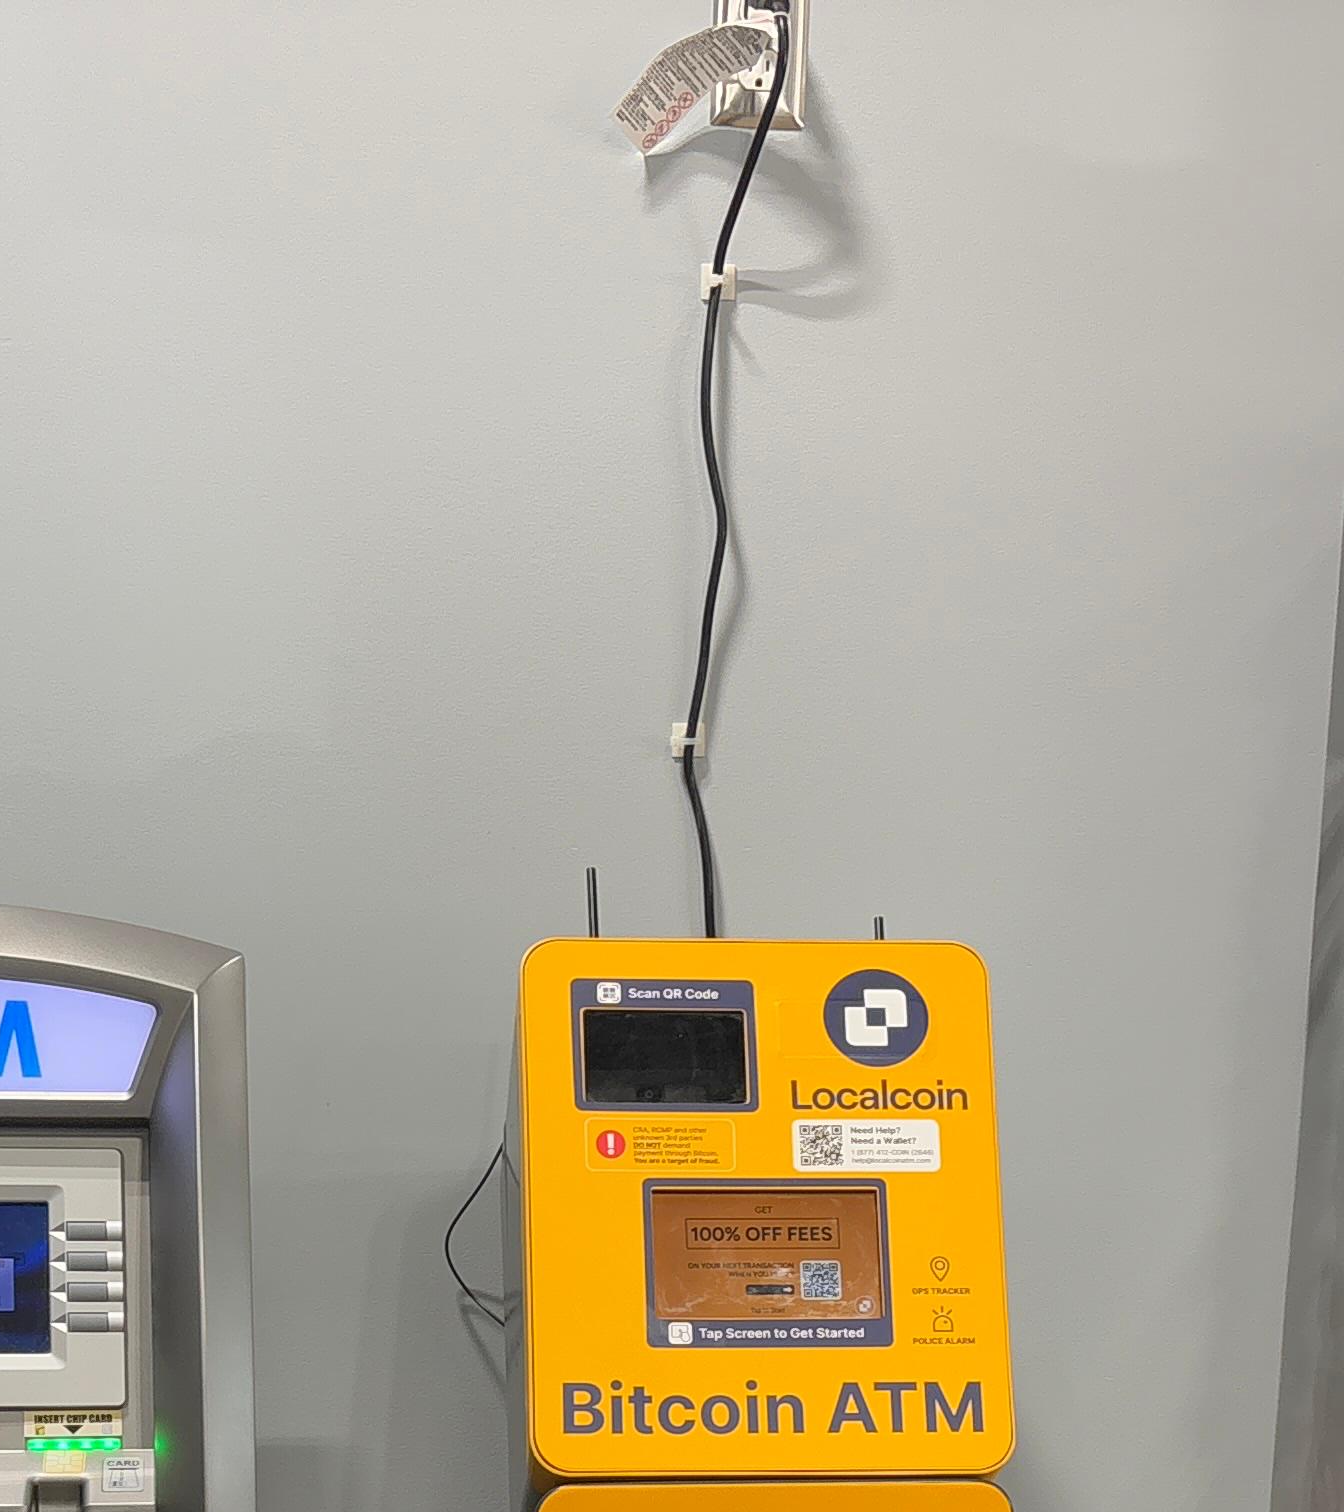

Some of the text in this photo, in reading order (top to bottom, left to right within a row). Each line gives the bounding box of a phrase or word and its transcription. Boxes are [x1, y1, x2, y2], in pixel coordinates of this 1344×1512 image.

[628, 988, 720, 1000] Scan QR Code
[791, 1079, 969, 1112] Localcoin
[876, 1127, 901, 1135] Help?
[883, 1137, 917, 1145] Wallet?
[755, 1206, 773, 1214] GET
[691, 1226, 833, 1242] 100% OFF FEES
[698, 1327, 865, 1341] Tap Screen to Get Started
[561, 1379, 986, 1435] Bitcoin ATM
[34, 1414, 113, 1424] INSERT CHIP CARD
